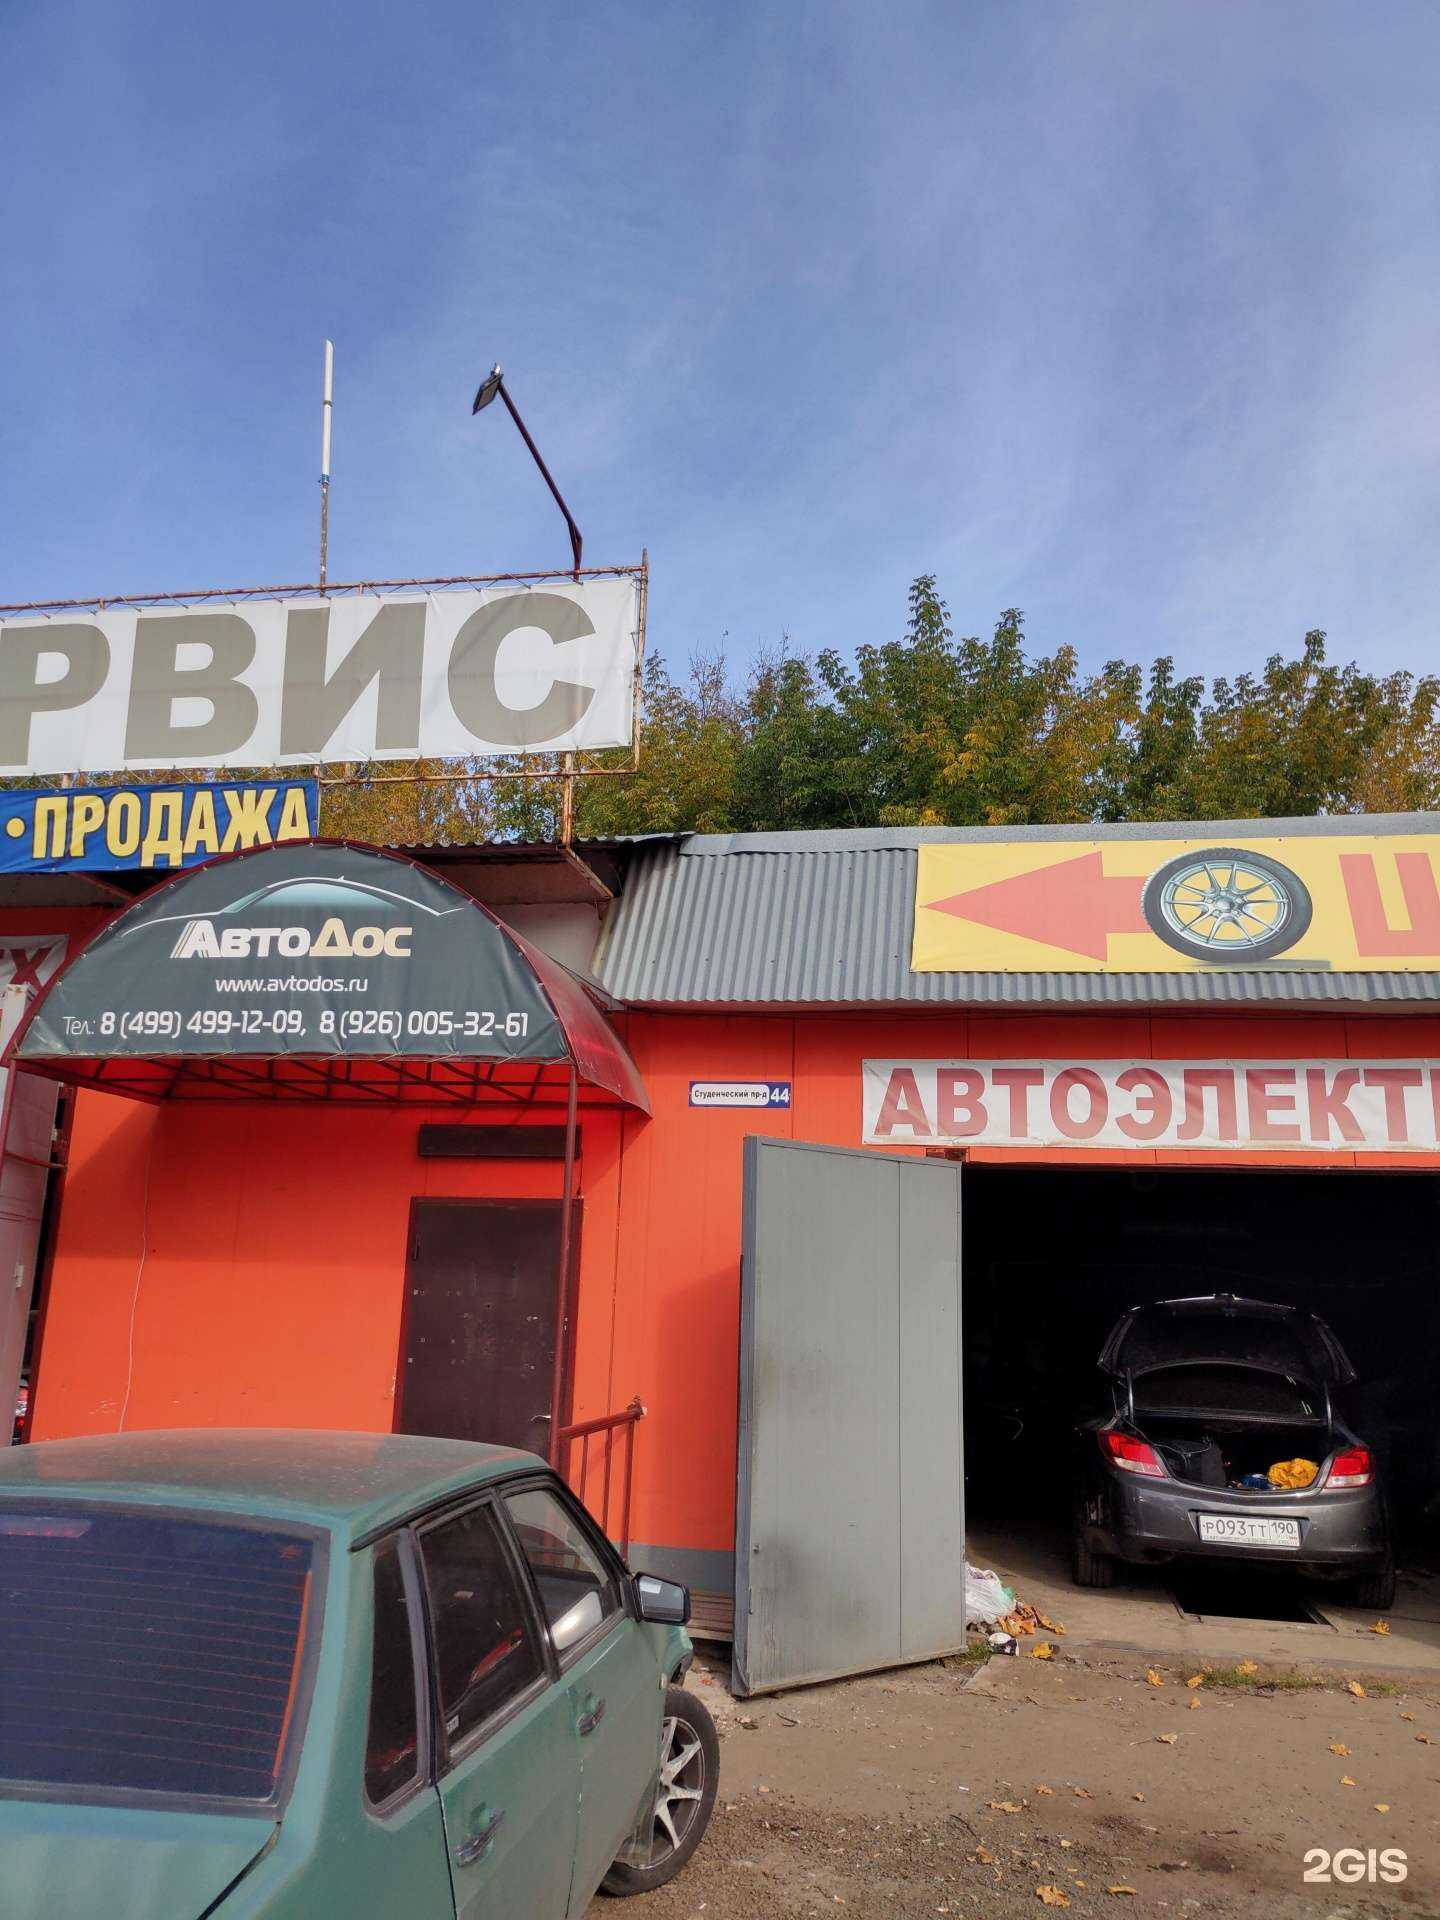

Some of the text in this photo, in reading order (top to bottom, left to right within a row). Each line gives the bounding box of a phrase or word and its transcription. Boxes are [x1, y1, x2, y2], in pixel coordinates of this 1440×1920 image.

[0, 592, 596, 766] РВИС
[32, 787, 311, 868] ПРОДАЖА
[215, 975, 368, 992] www.avtodos.ru
[100, 1011, 116, 1035] 8
[120, 1010, 182, 1039] (499)
[186, 1009, 307, 1036] 499-12-09,
[319, 1010, 335, 1033] 8
[340, 1010, 402, 1039] (926)
[407, 1011, 529, 1036] 005-32-61
[694, 1089, 749, 1099] Студенческий
[770, 1087, 790, 1103] 44
[874, 1067, 1440, 1142] АВТОЭЛЕКТ
